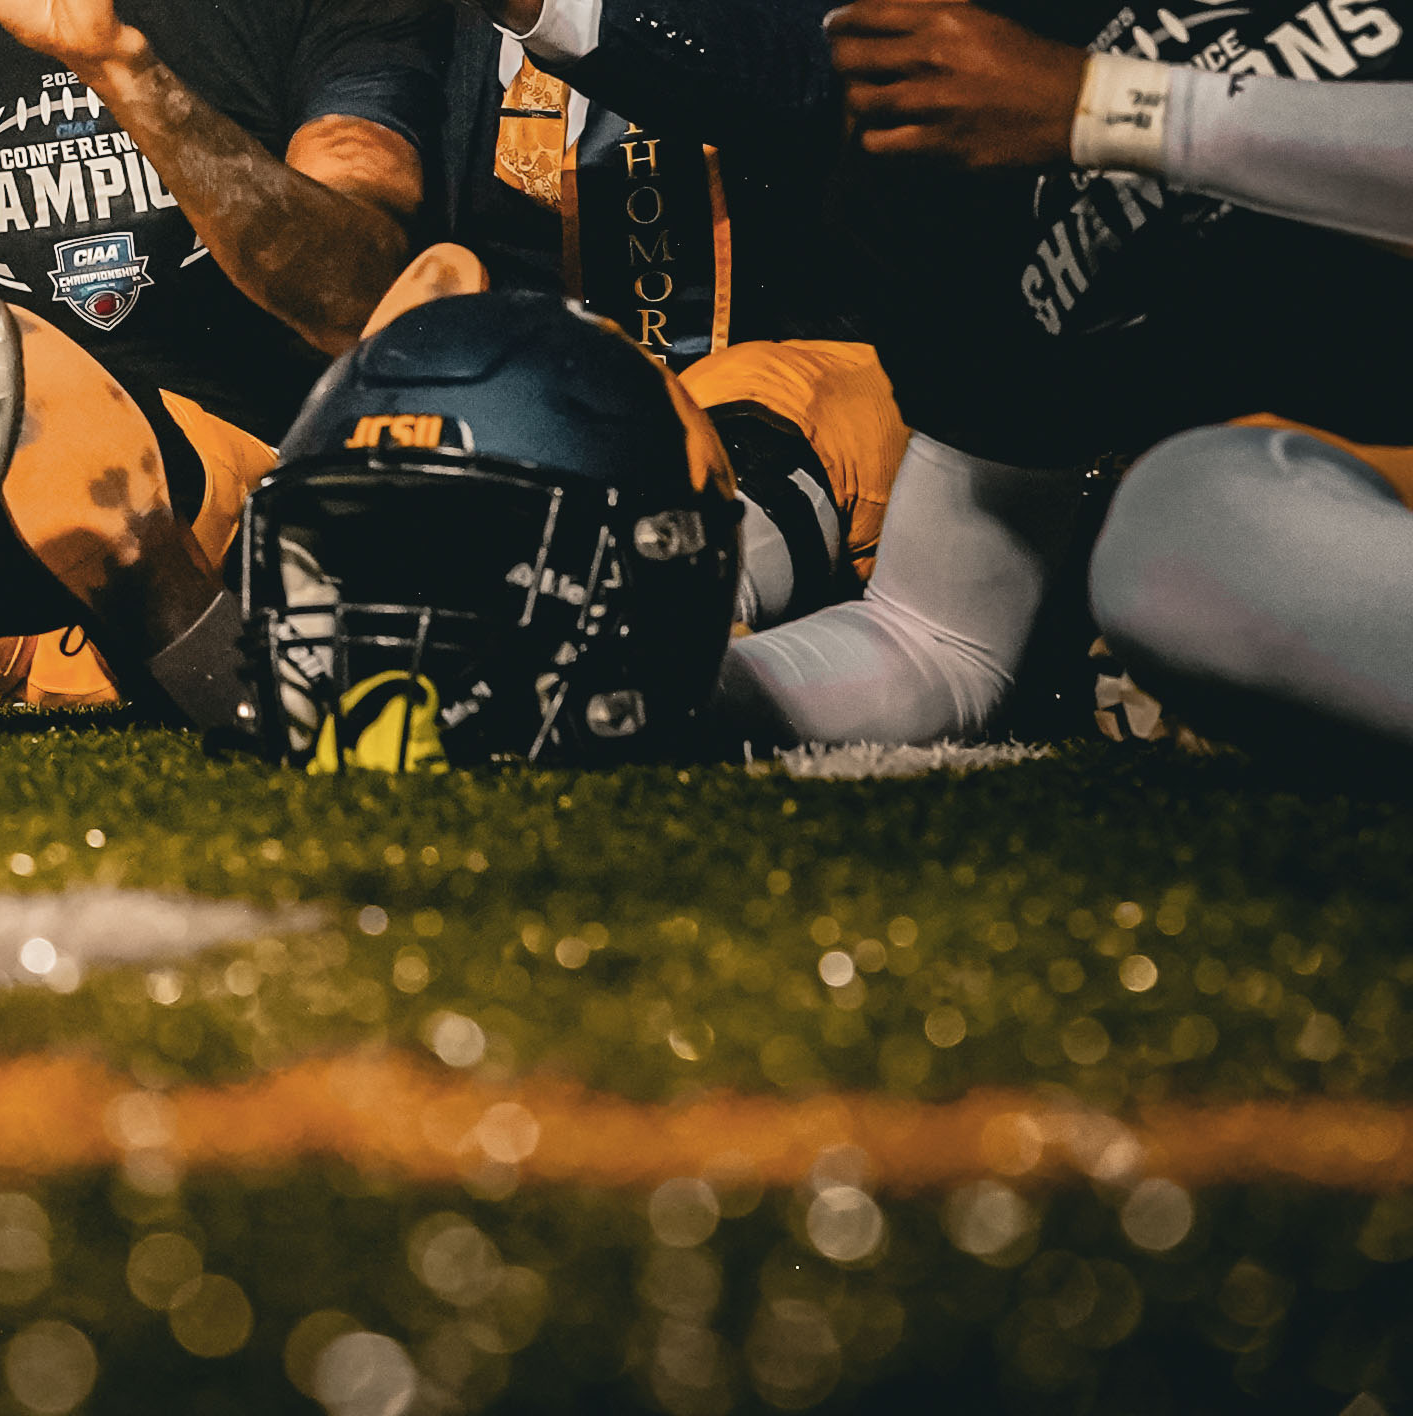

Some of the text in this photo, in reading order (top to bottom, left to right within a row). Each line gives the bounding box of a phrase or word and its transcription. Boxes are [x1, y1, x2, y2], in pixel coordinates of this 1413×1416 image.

[41, 71, 80, 88] 202
[0, 130, 139, 170] CONFEREN
[73, 244, 119, 267] CIAA
[58, 265, 140, 288] CHAMPIONSHIP
